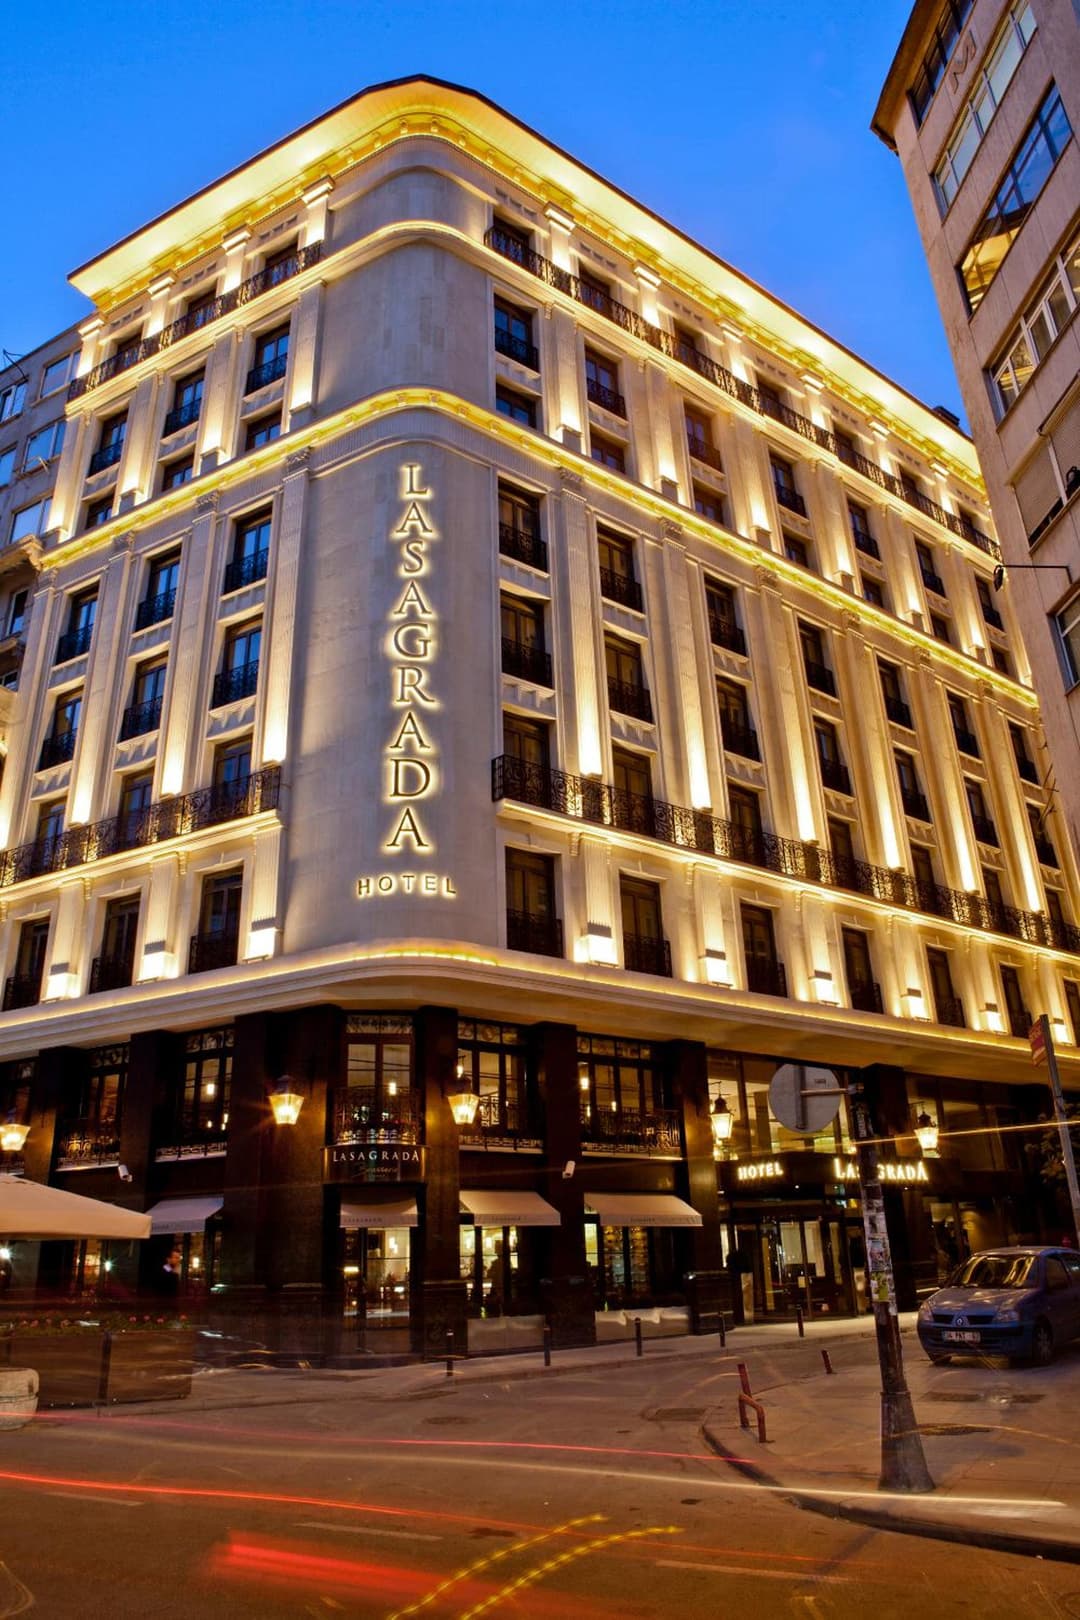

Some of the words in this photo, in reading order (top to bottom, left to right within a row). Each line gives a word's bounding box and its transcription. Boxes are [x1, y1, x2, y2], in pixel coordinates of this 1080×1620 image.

[386, 463, 436, 849] LASAGRADA
[357, 874, 457, 896] HOTEL
[332, 1149, 420, 1162] LASAGRADA
[737, 1161, 784, 1181] HOTEL
[833, 1157, 929, 1181] LAGRADA
